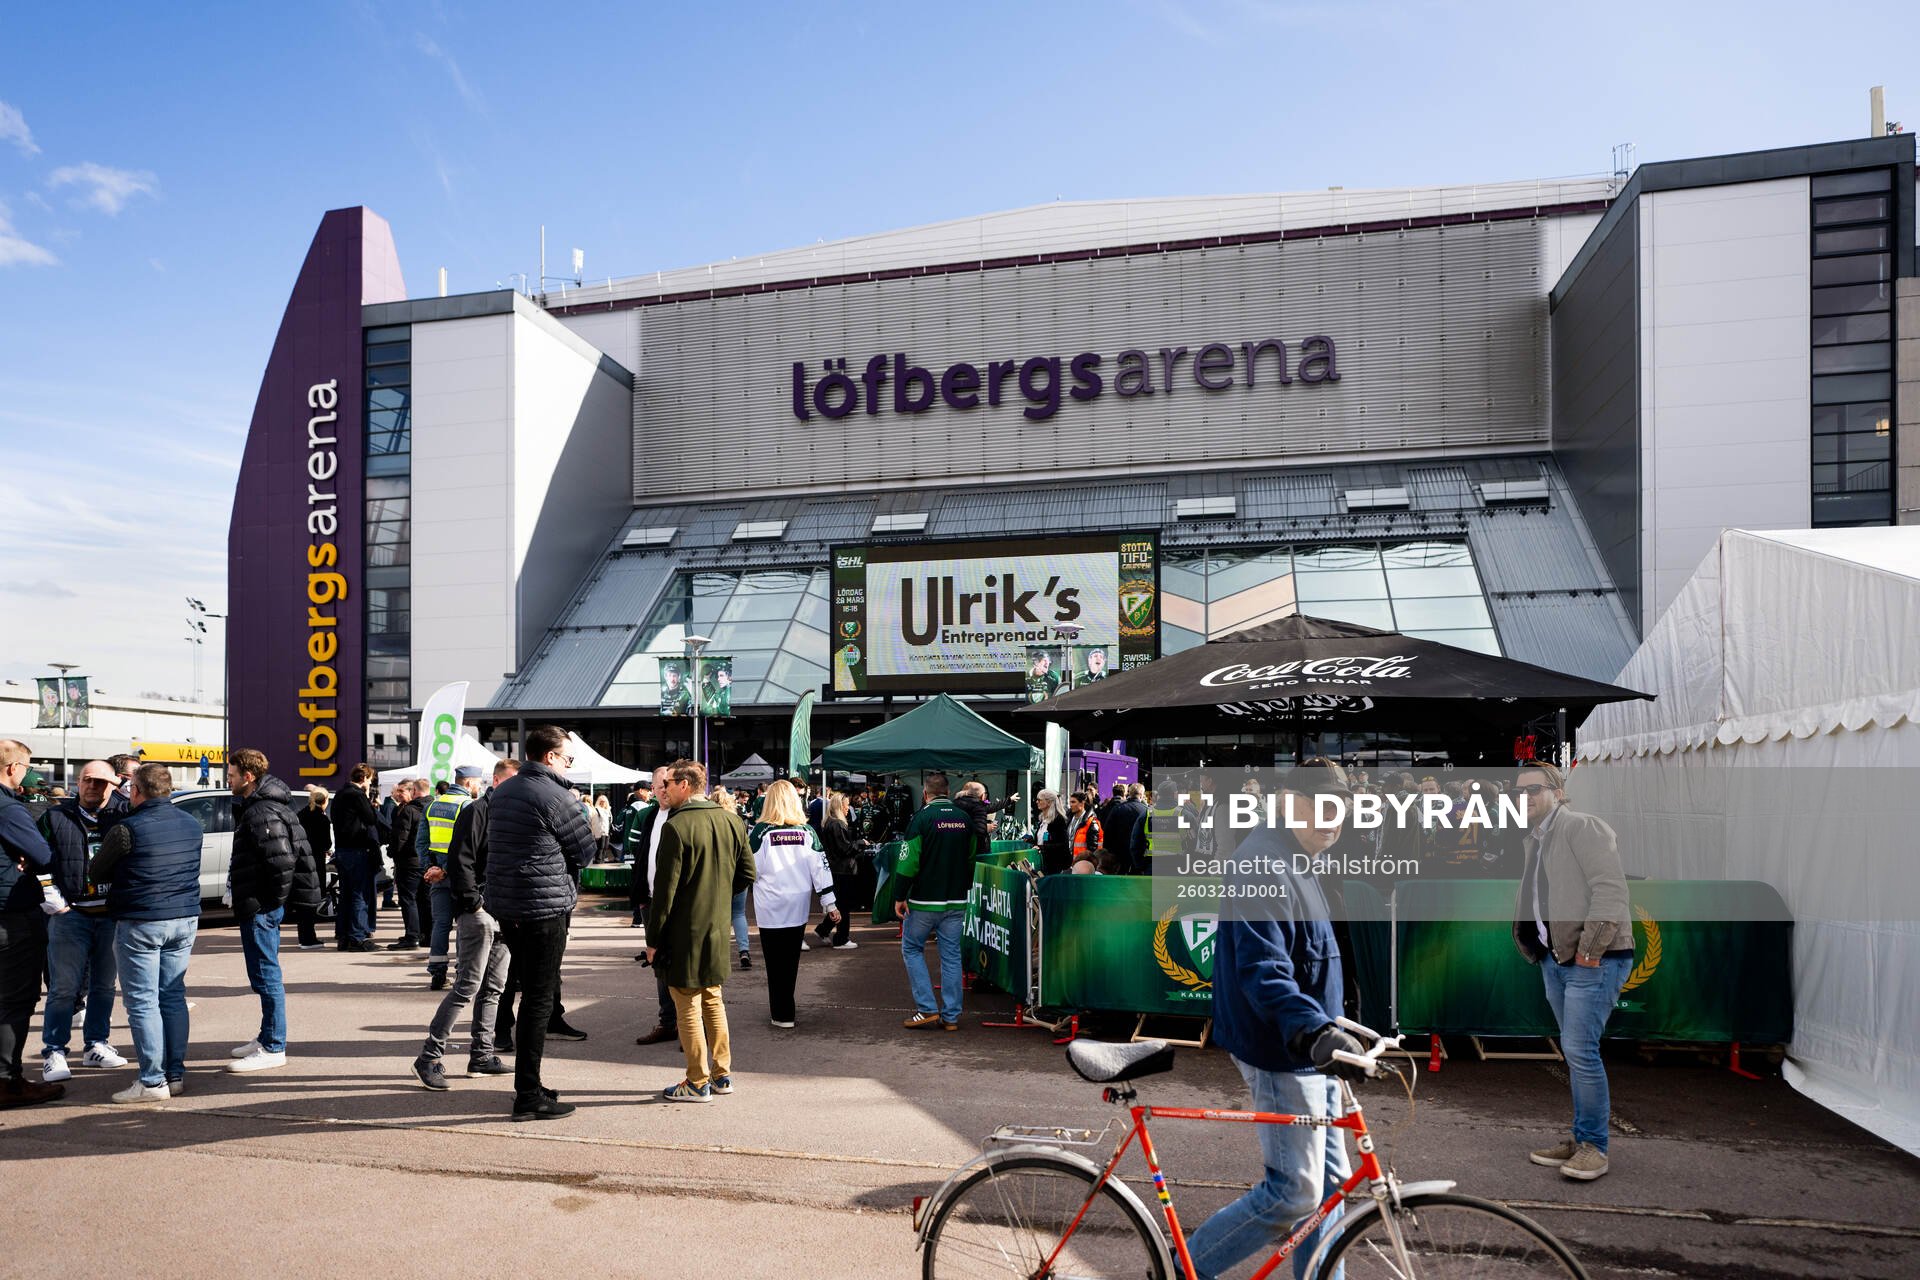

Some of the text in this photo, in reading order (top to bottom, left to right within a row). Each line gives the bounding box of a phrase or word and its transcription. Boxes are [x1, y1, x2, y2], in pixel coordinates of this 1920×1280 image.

[902, 573, 1082, 646] Ulrik's
[941, 626, 1048, 647] Entreprenad
[1200, 656, 1418, 687] Coca-Cola
[1249, 677, 1373, 690] ZERO SUGAR
[431, 713, 457, 797] coo
[1443, 762, 1454, 773] 10
